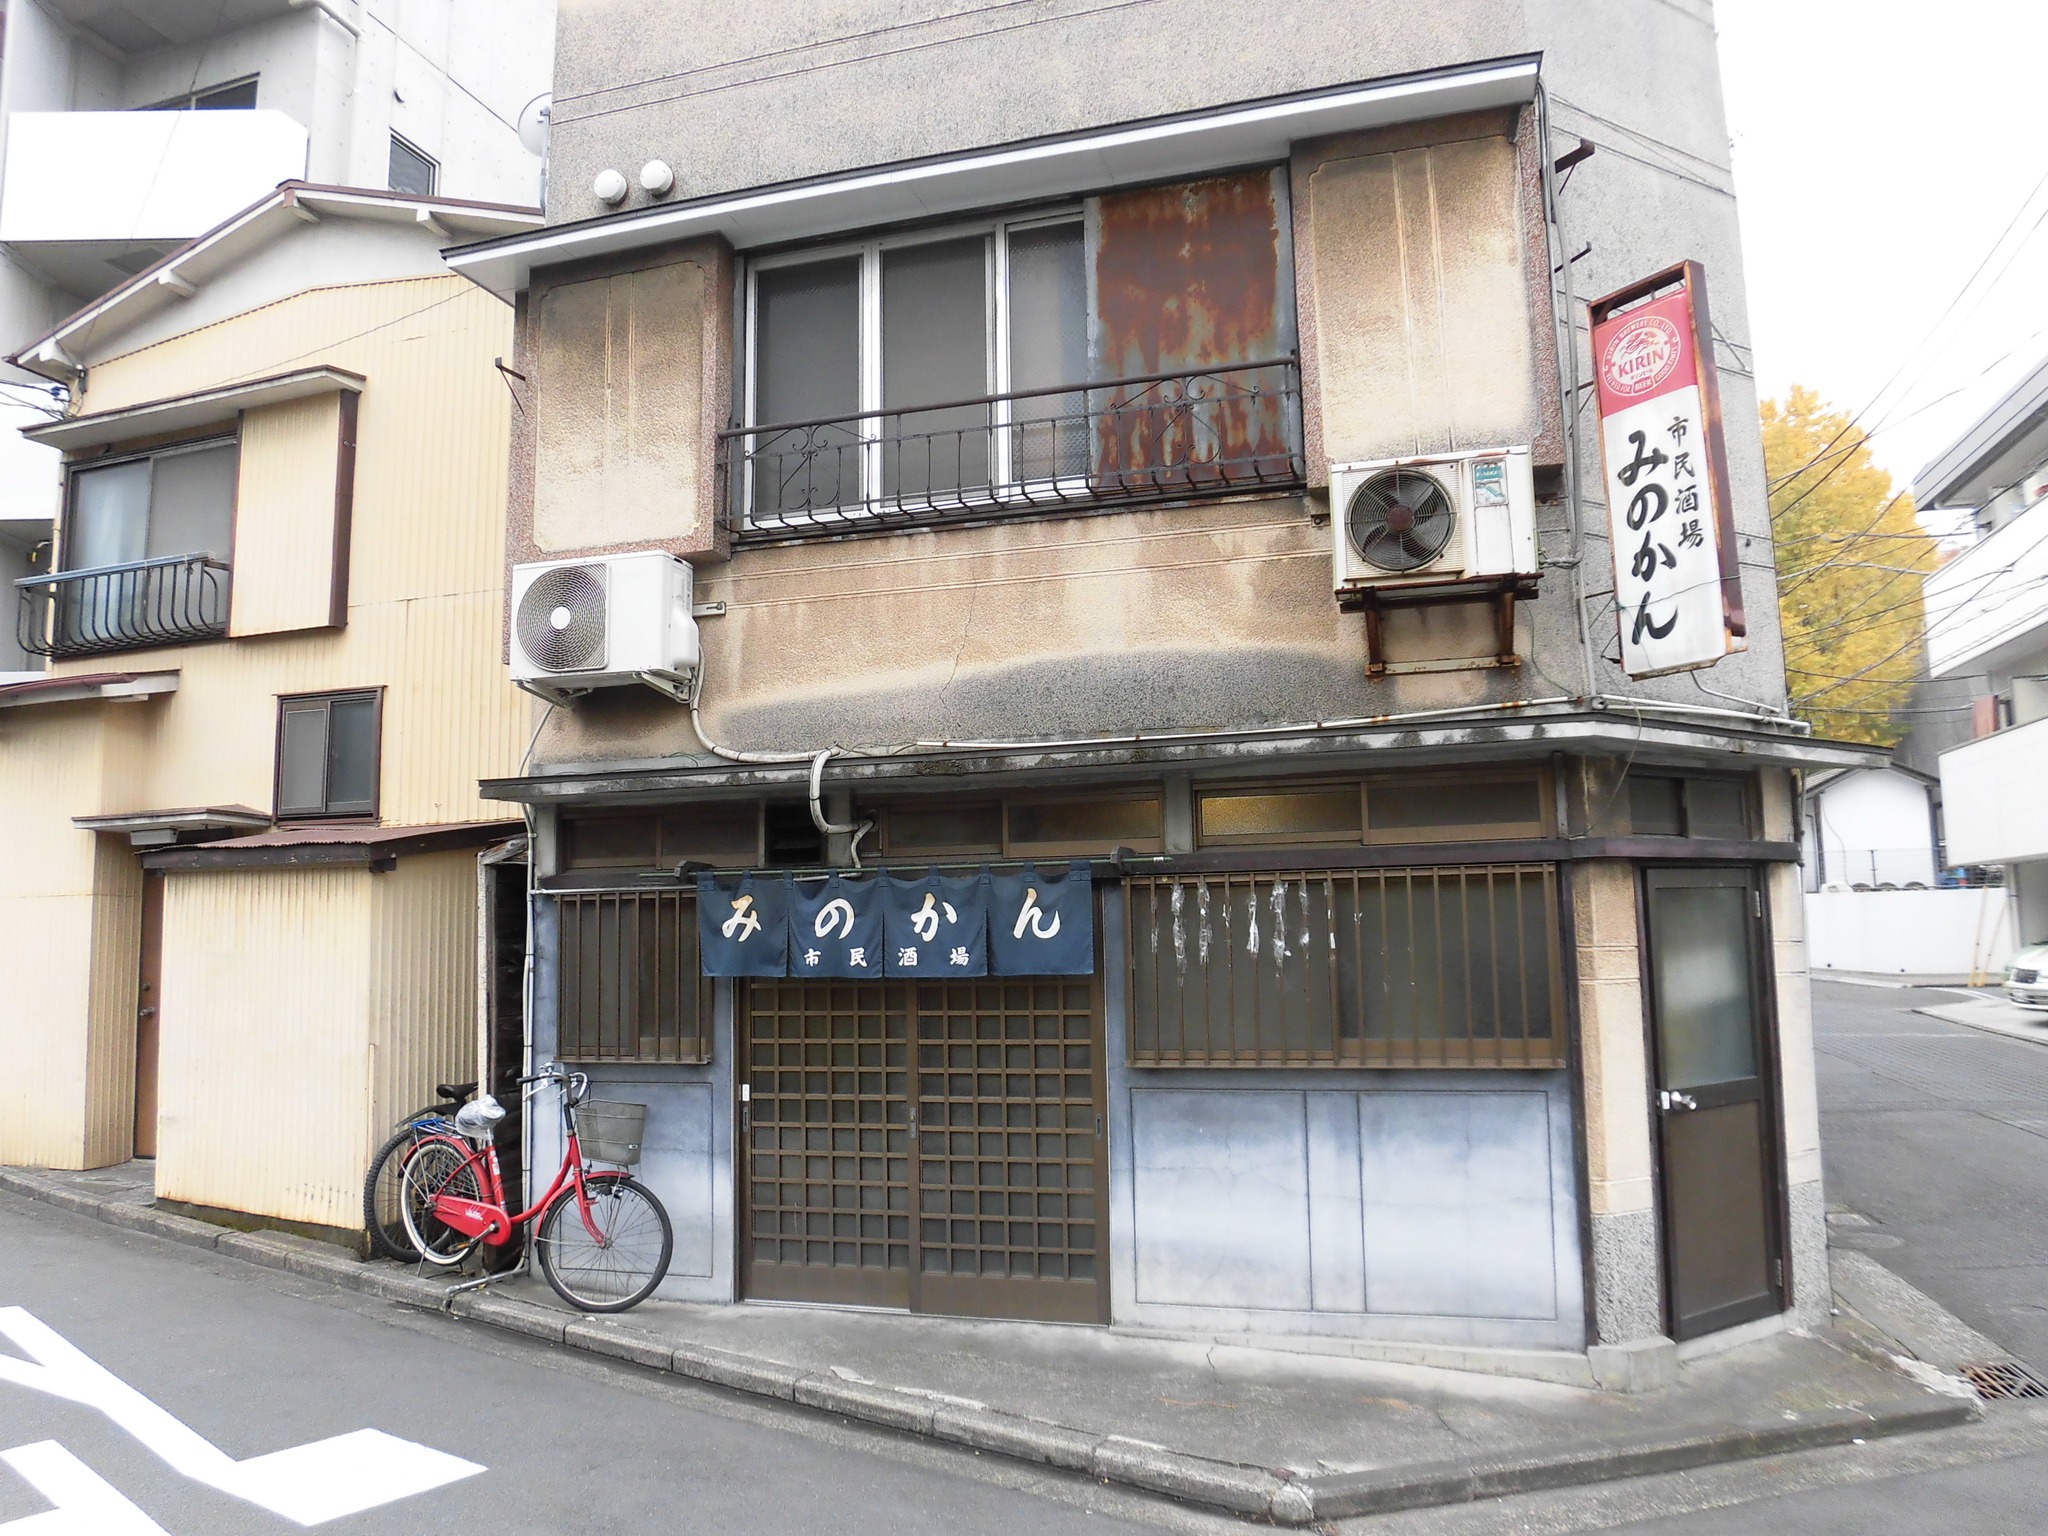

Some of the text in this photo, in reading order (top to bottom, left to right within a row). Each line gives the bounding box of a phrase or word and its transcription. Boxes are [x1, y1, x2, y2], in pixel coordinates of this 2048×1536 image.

[1618, 347, 1665, 378] KIRIN
[1635, 379, 1652, 389] BEER
[1666, 415, 1704, 550] 市民酒場
[1617, 429, 1679, 645] みのかん
[721, 887, 1061, 943] みのかん
[803, 946, 970, 968] 市民酒場
